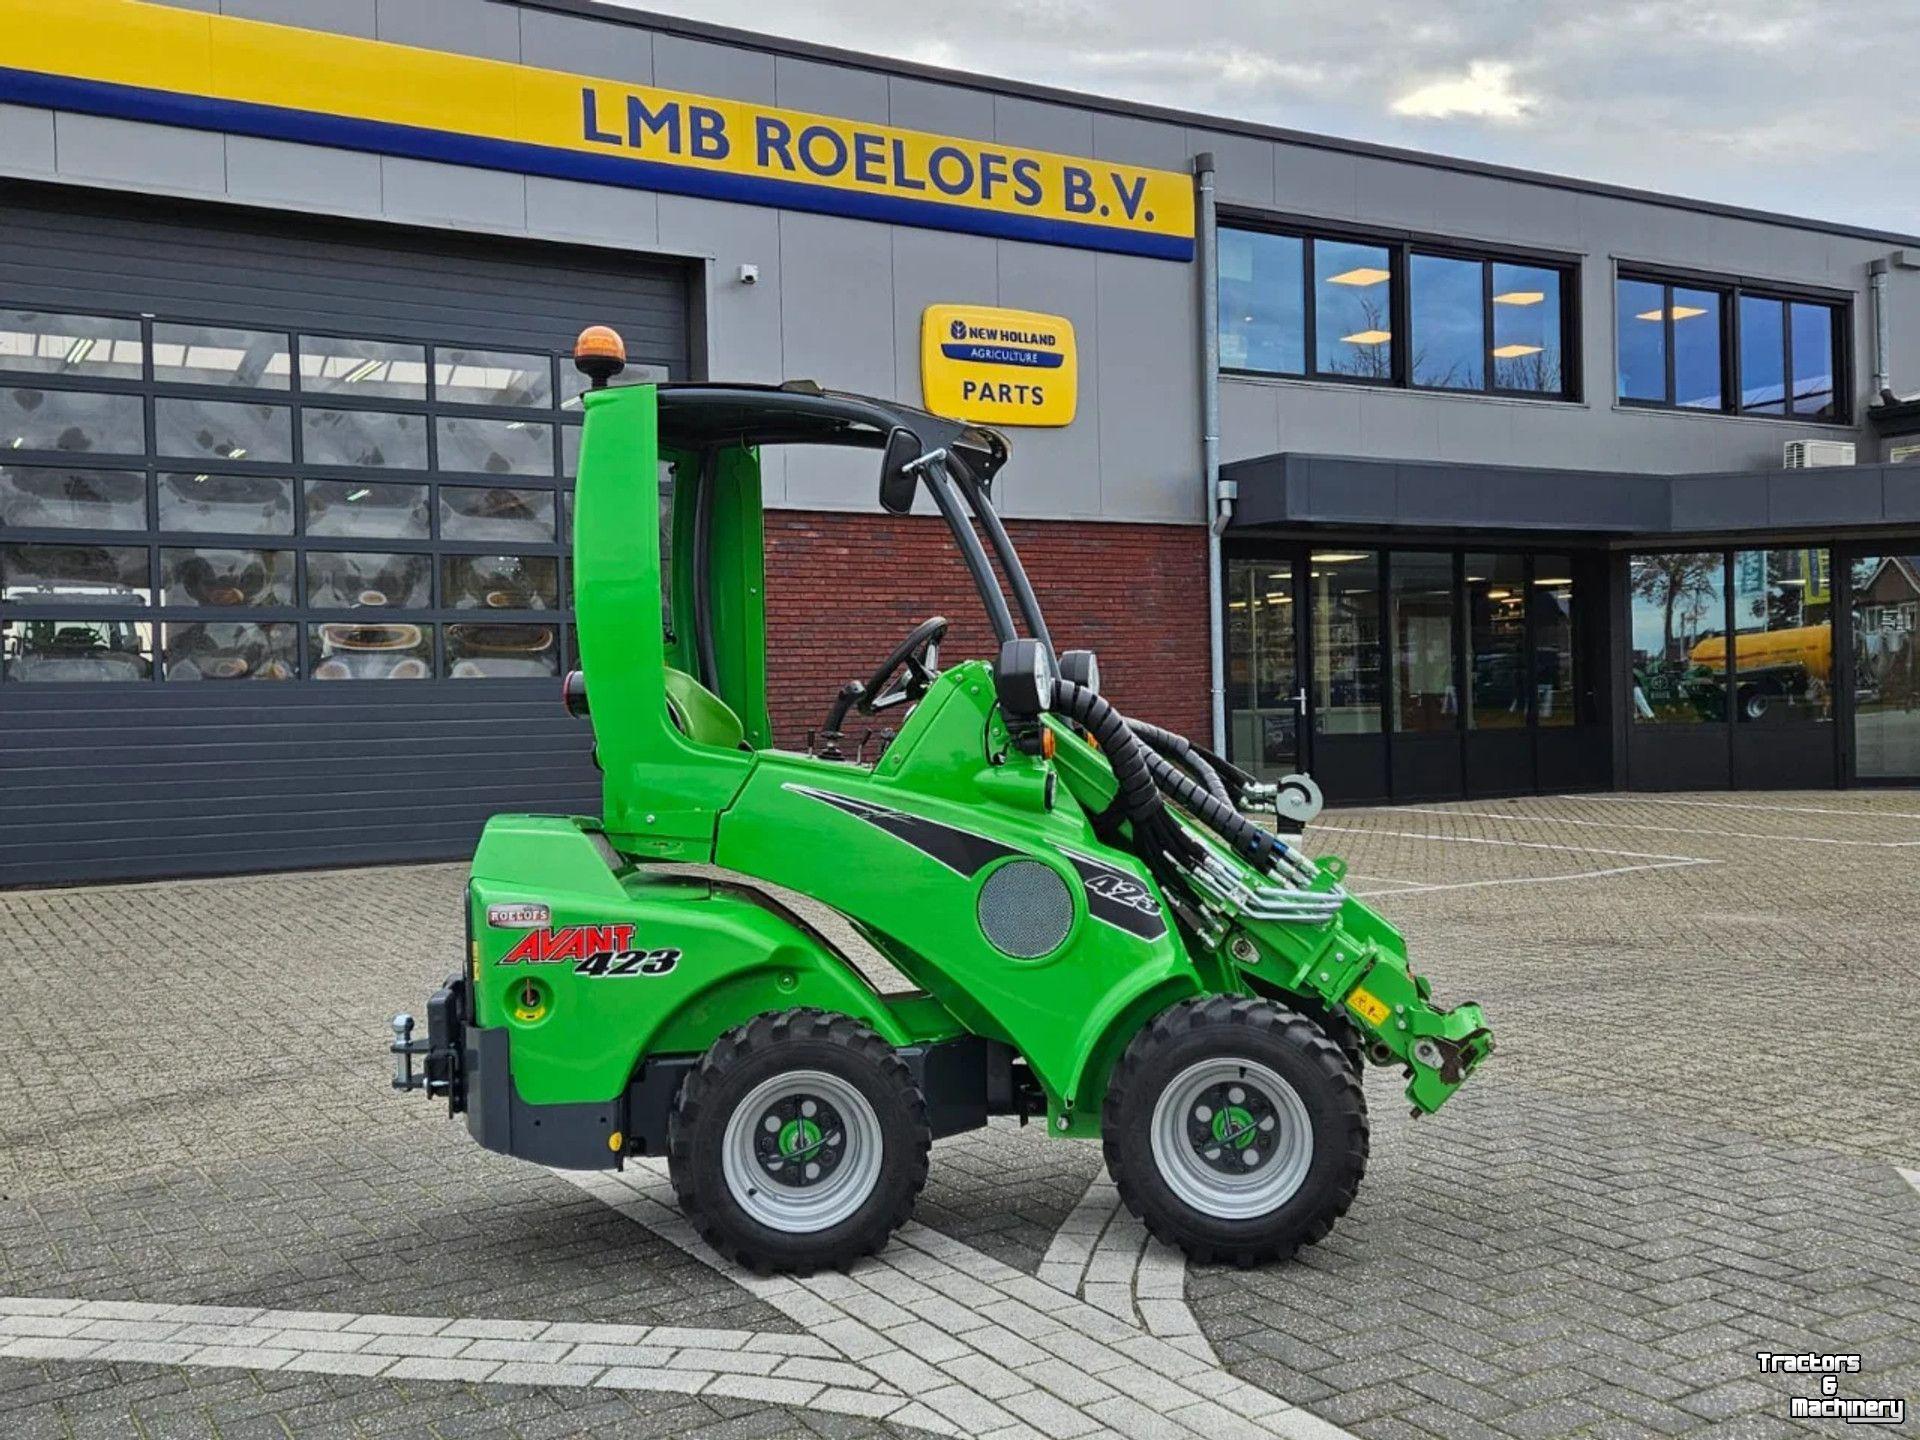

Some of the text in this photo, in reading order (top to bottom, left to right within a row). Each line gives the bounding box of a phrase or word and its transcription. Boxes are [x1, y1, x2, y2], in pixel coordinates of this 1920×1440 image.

[582, 88, 1155, 222] LMB ROELOFS B.V.
[969, 326, 1056, 346] NEW HOLLAND
[971, 348, 1038, 363] AGRICULTURE
[963, 380, 1044, 406] PARTS
[1084, 874, 1162, 916] 423
[490, 910, 549, 921] ROELOFS
[497, 923, 636, 965] AVANT
[574, 948, 682, 979] 423
